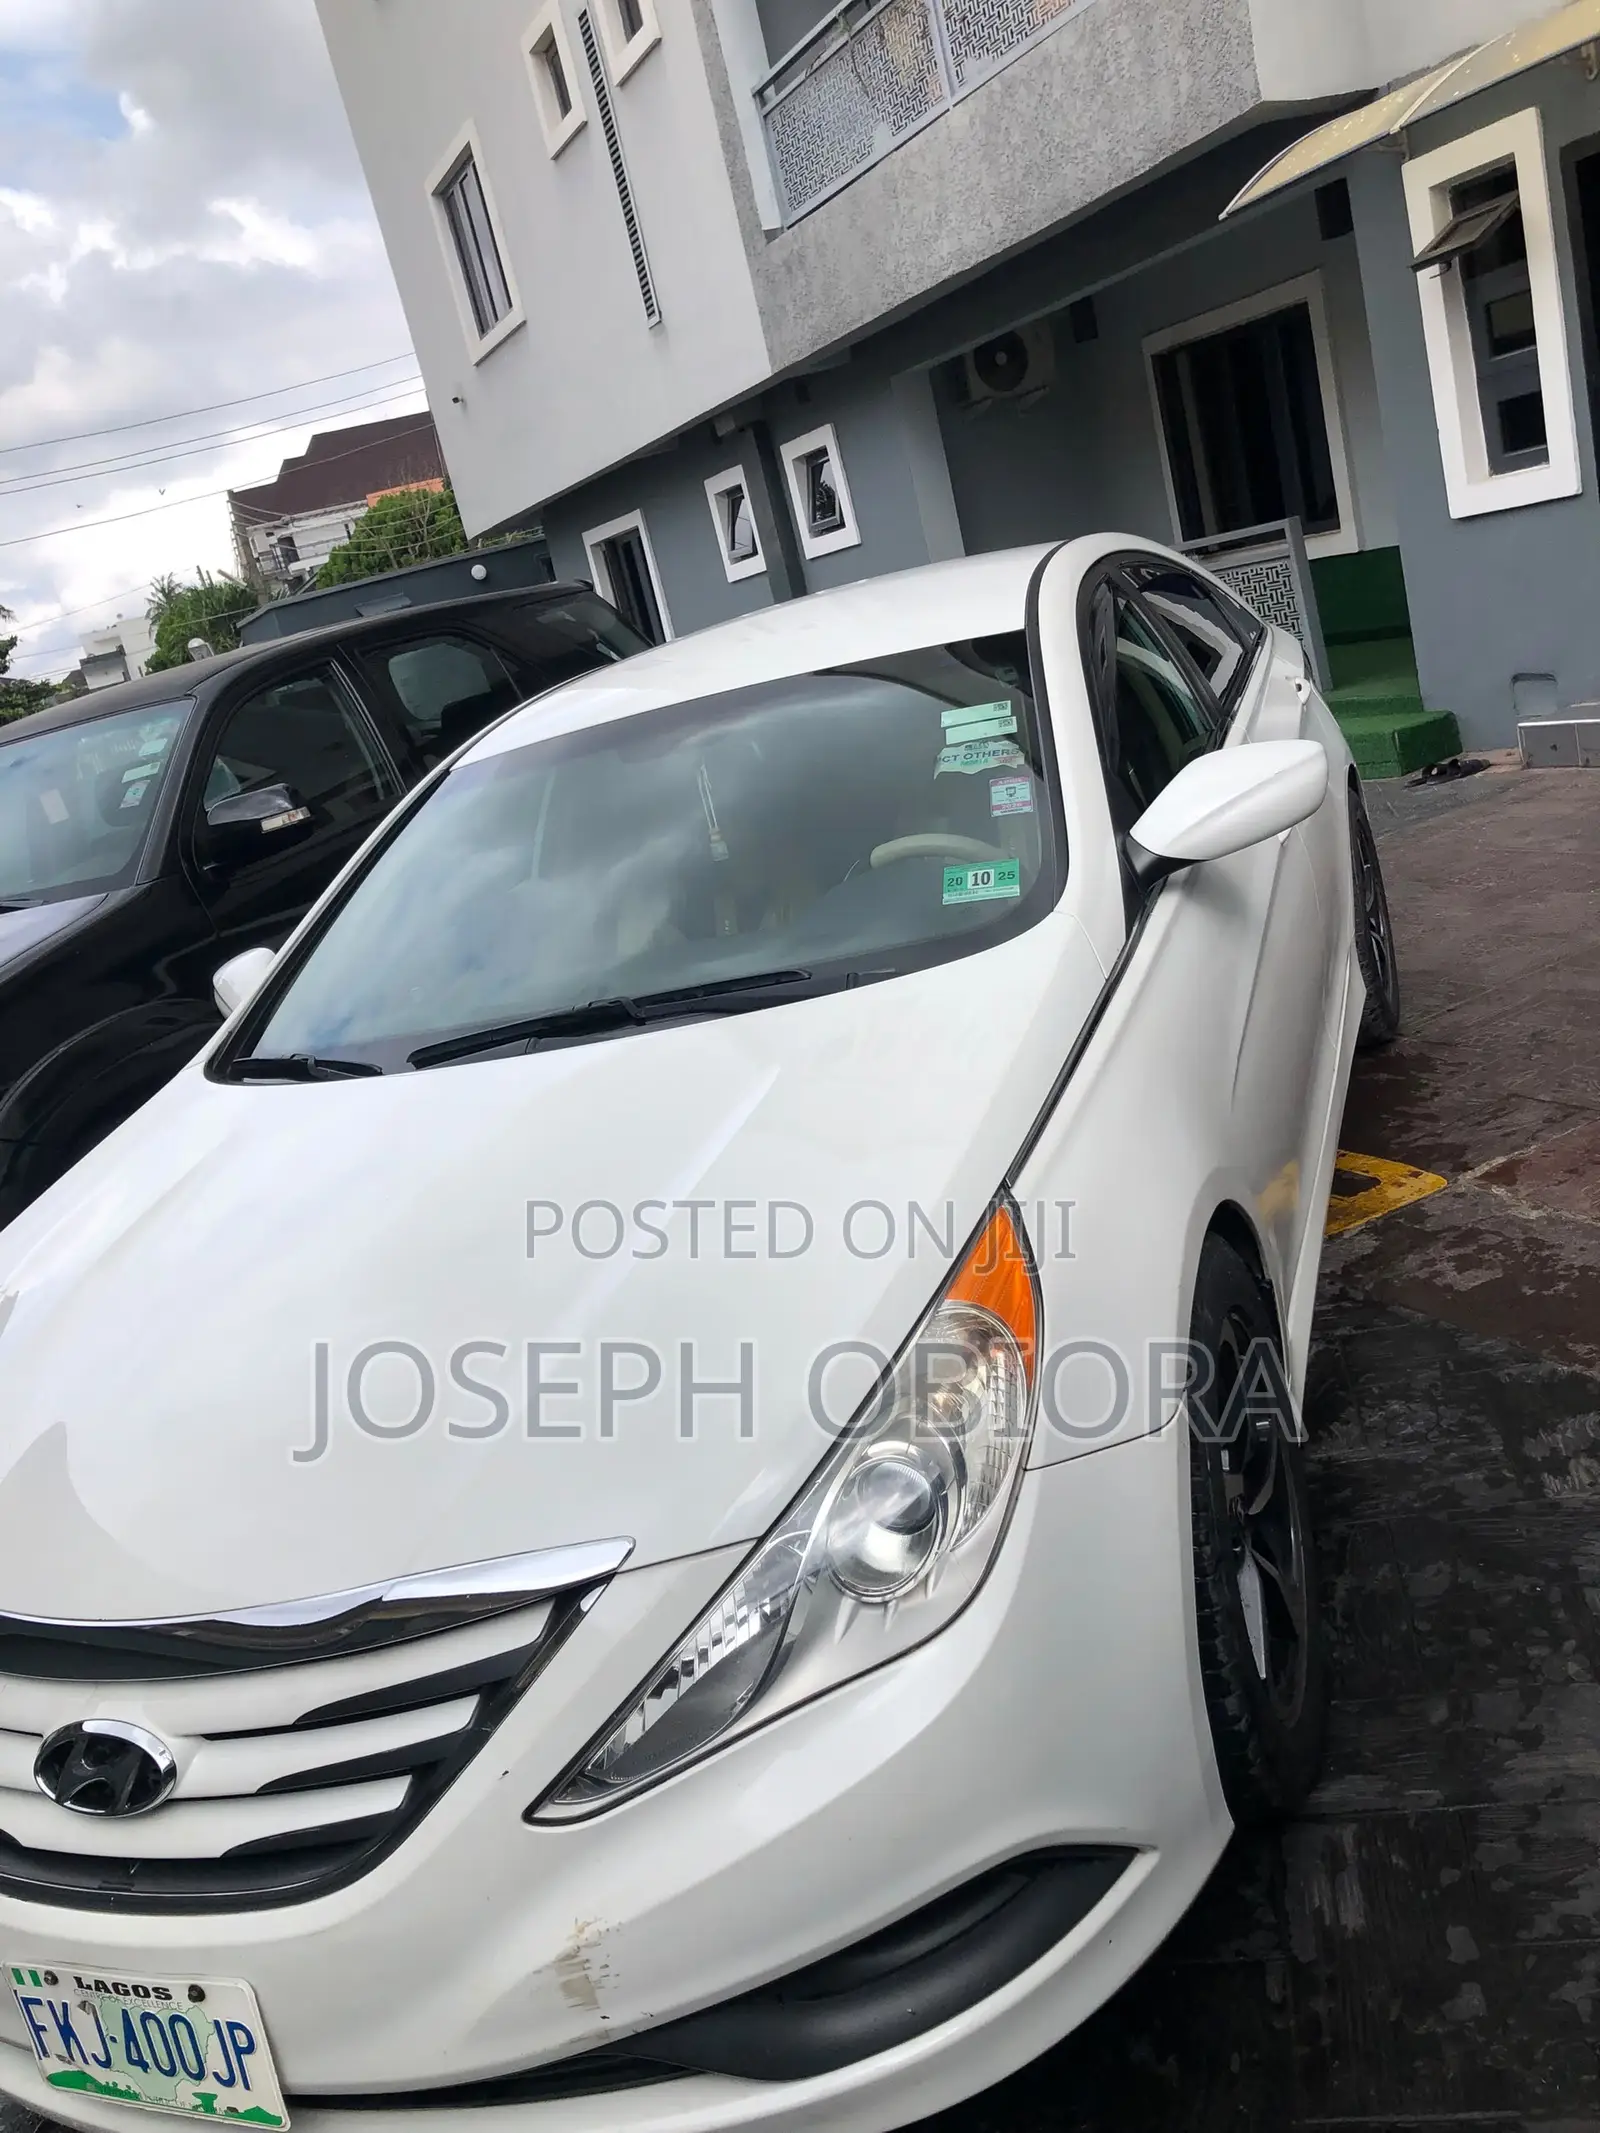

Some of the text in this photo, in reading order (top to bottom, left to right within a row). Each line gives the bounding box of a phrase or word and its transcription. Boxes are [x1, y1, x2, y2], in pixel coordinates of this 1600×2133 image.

[963, 748, 1020, 760] OTHERS
[947, 870, 1016, 887] 20 10 25
[72, 1975, 173, 2001] LAGOS
[123, 1997, 183, 2011] EXCELLENCE
